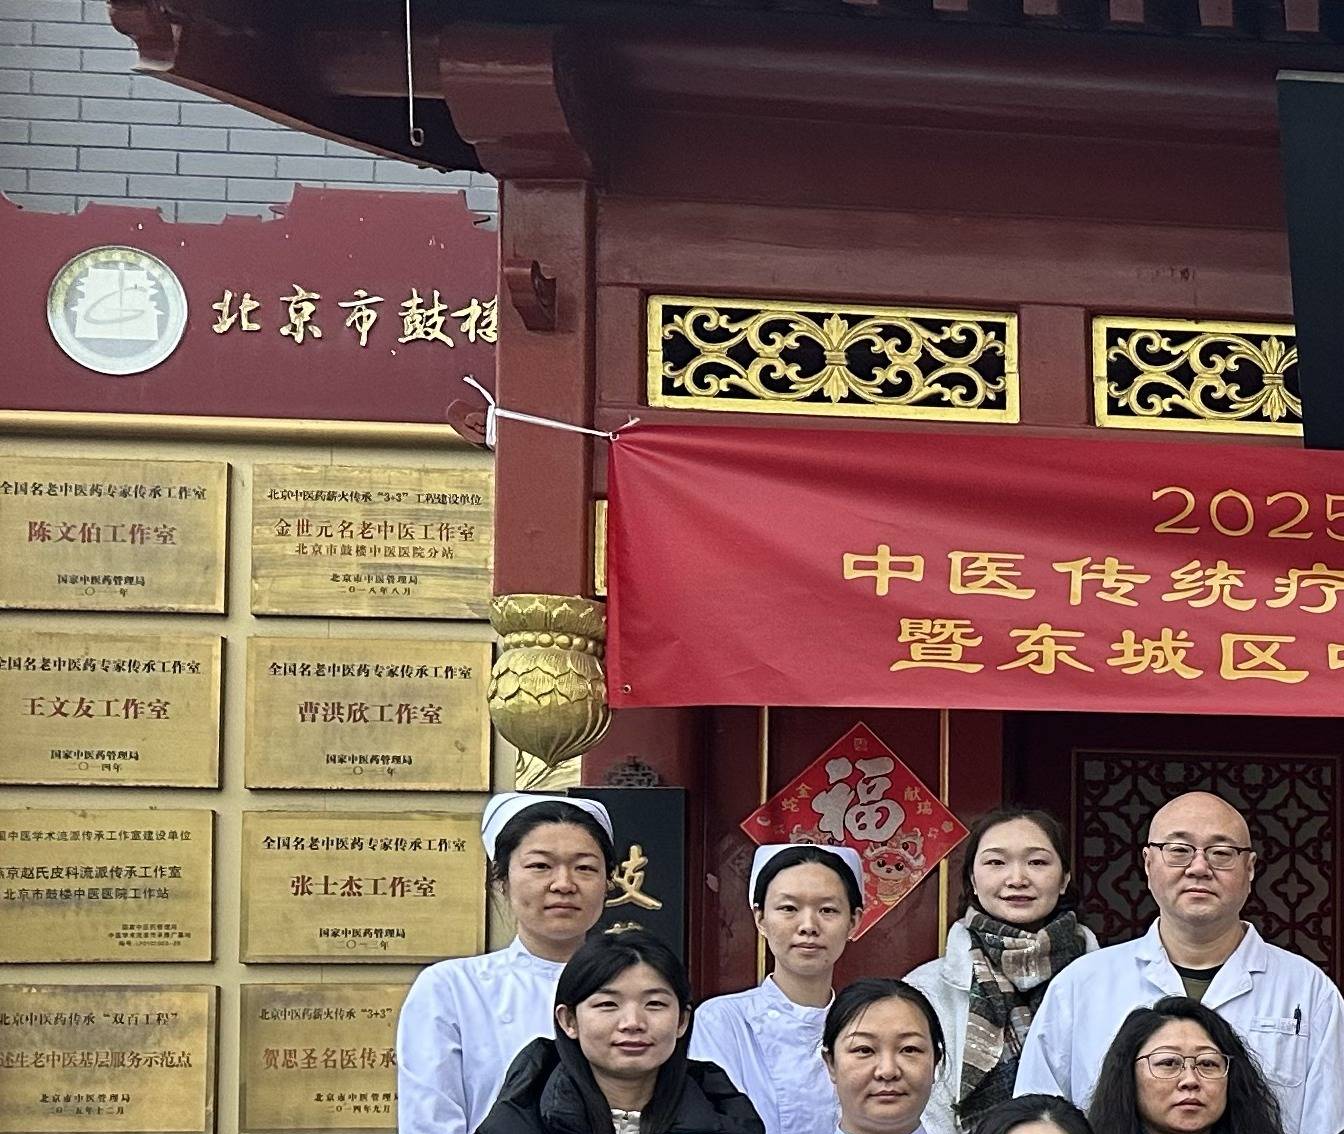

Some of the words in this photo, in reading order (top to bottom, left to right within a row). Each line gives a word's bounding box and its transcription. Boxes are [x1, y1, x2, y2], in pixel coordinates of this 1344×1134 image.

[0, 481, 207, 500] 全国名老中医药专家传承工作室
[28, 521, 177, 545] 陈文伯工作室
[274, 518, 475, 542] 金世元名老中医工作室
[295, 543, 454, 559] 北京市鼓楼中医医院分站
[57, 574, 146, 586] 国家中医药管理局
[330, 573, 418, 585] 北京市中医管理局
[268, 662, 473, 679] 全国名老中医药专家传承工作室
[22, 696, 171, 719] 王文友工作室
[297, 702, 443, 725] 曹洪欣工作室
[50, 750, 139, 761] 国家中医药管理局
[326, 753, 413, 765] 国家中医药管理局
[811, 756, 906, 842] 福
[263, 836, 466, 852] 全国名老中医药专家传承工作室
[4, 887, 169, 900] 北京市鼓楼中医医院工作站
[290, 874, 436, 898] 张士杰工作室
[319, 927, 406, 939] 国家中医药管理局
[40, 1093, 130, 1103] 北京市中医管理局
